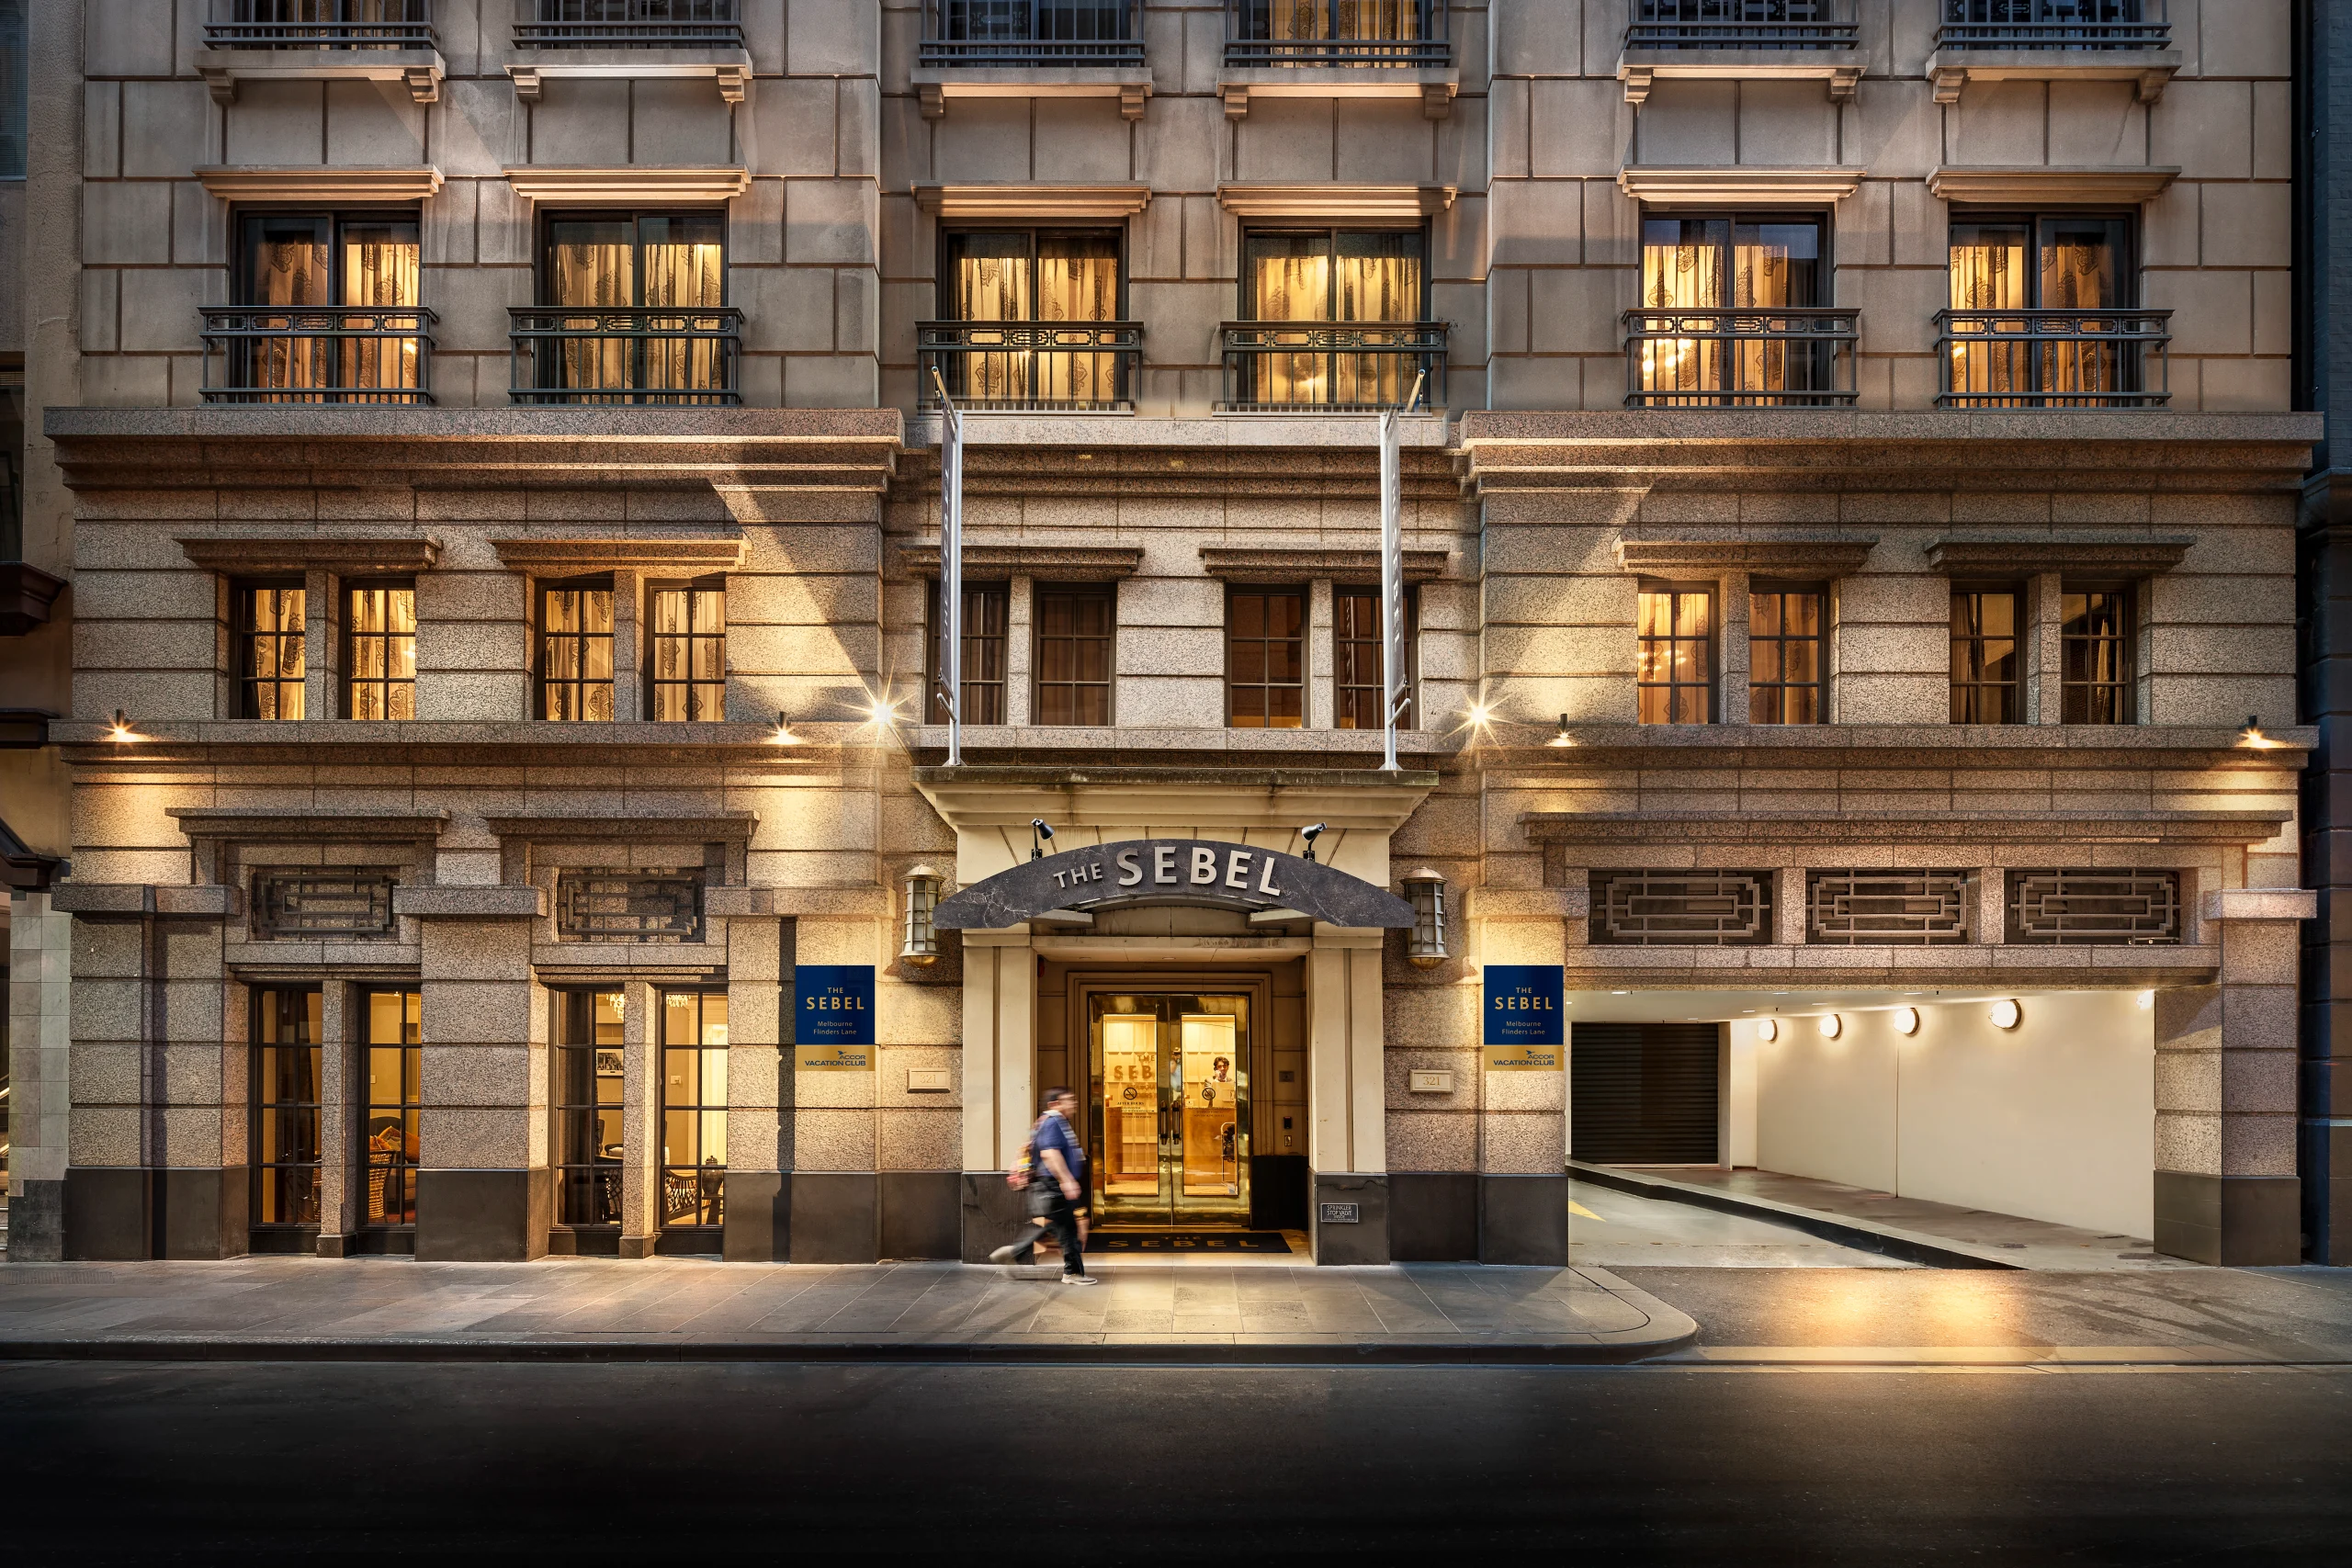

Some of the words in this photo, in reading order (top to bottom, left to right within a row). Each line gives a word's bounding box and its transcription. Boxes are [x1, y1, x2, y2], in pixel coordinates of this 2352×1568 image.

[1053, 862, 1103, 888] THE
[1116, 846, 1281, 897] SEBEL
[806, 997, 865, 1010] SEBEL
[1495, 997, 1553, 1010] SEBEL
[920, 1074, 937, 1084] 321
[1422, 1076, 1441, 1086] 321
